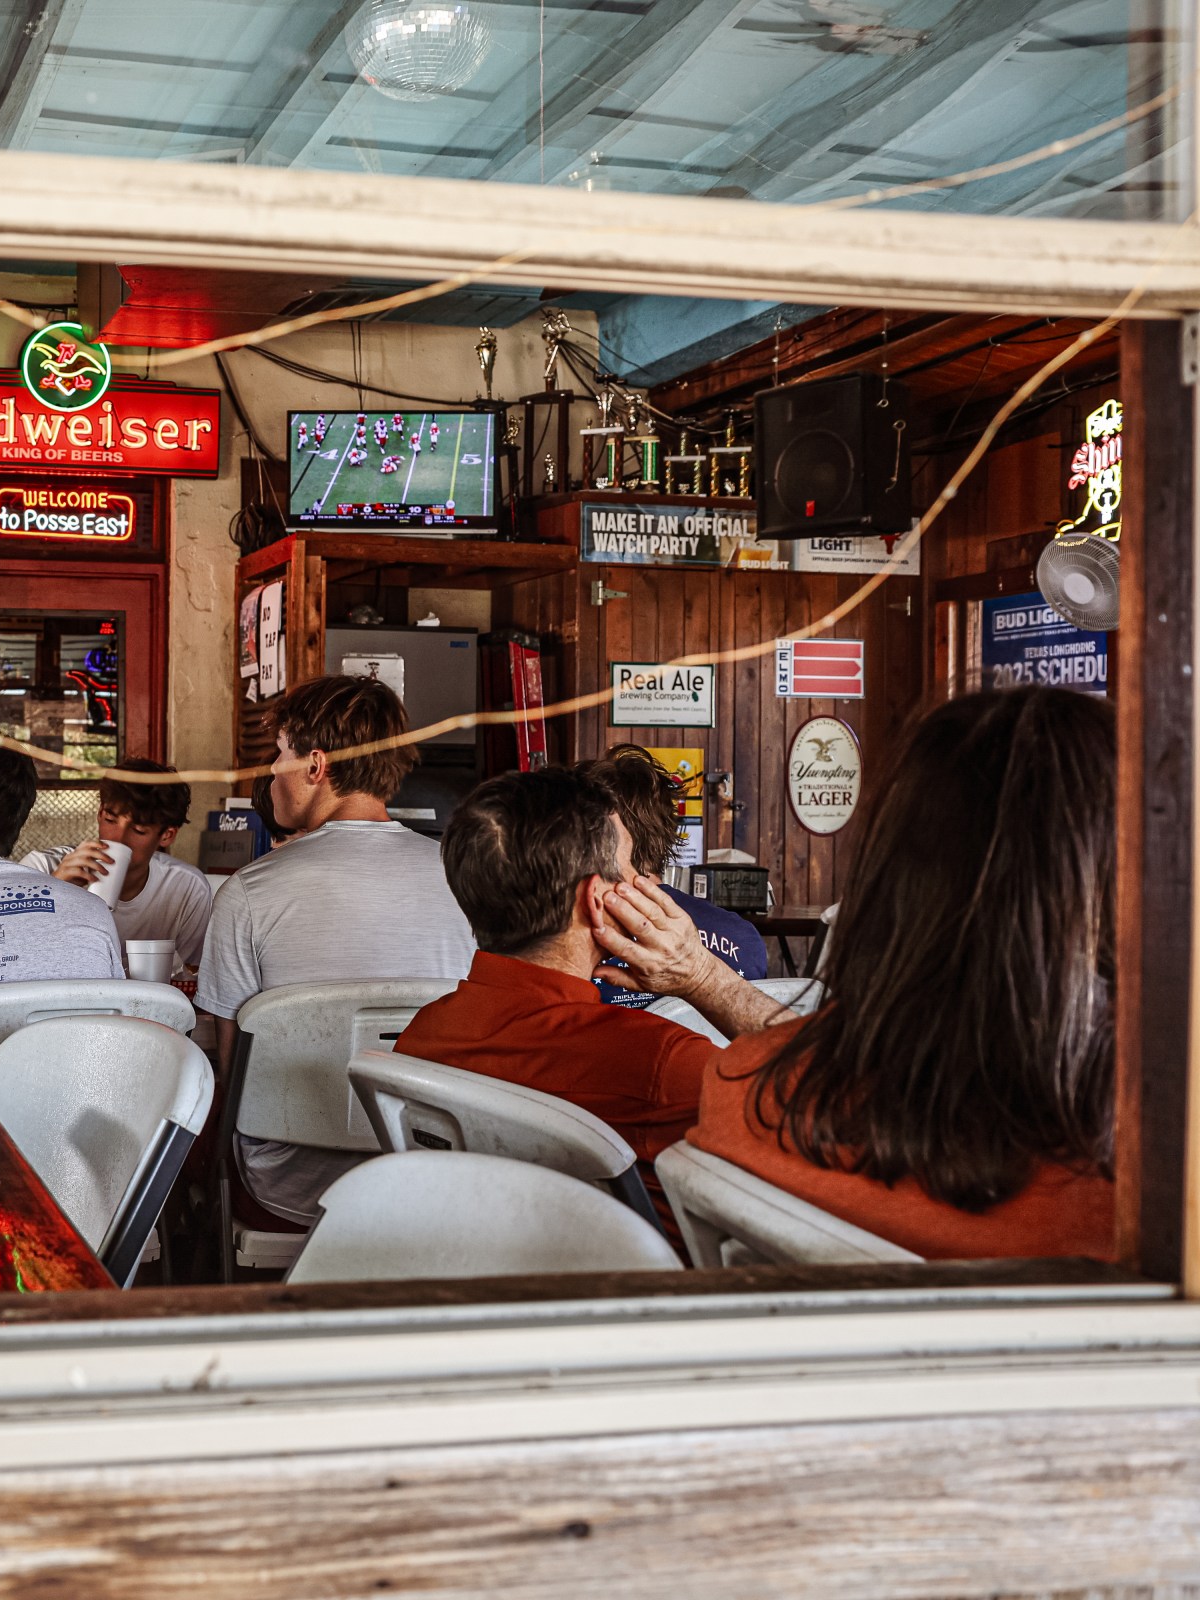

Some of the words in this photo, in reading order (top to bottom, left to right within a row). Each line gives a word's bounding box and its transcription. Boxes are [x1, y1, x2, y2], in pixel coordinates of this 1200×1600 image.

[2, 447, 41, 460] KING
[44, 449, 67, 461] OF
[71, 450, 123, 463] BEERS
[23, 490, 108, 509] WELCOME
[0, 507, 20, 530] to
[24, 509, 80, 532] Posse
[82, 511, 128, 536] East
[592, 511, 636, 533] MAKE
[640, 514, 654, 534] IT
[657, 515, 678, 535] AN
[684, 516, 750, 537] OFFICIAL
[593, 532, 647, 553] WATCH
[650, 536, 699, 556] PARTY
[810, 537, 852, 551] LIGHT
[741, 559, 760, 569] BUD
[760, 559, 789, 571] LIGHT
[263, 605, 271, 622] NO
[996, 612, 1027, 630] BUD
[1028, 607, 1065, 626] LIGH
[779, 640, 789, 648] ST
[1025, 646, 1049, 659] TEXAS
[1049, 641, 1096, 657] LONGHORNS
[620, 668, 664, 691] Real
[671, 669, 704, 691] Ale
[778, 652, 789, 693] ELMO
[993, 662, 1033, 689] 2025
[620, 691, 652, 701] Brewing
[654, 692, 691, 702] Company
[791, 760, 857, 782] Yuengling
[798, 791, 853, 806] LAGER
[698, 929, 740, 963] RACK
[1, 955, 19, 963] GROUP
